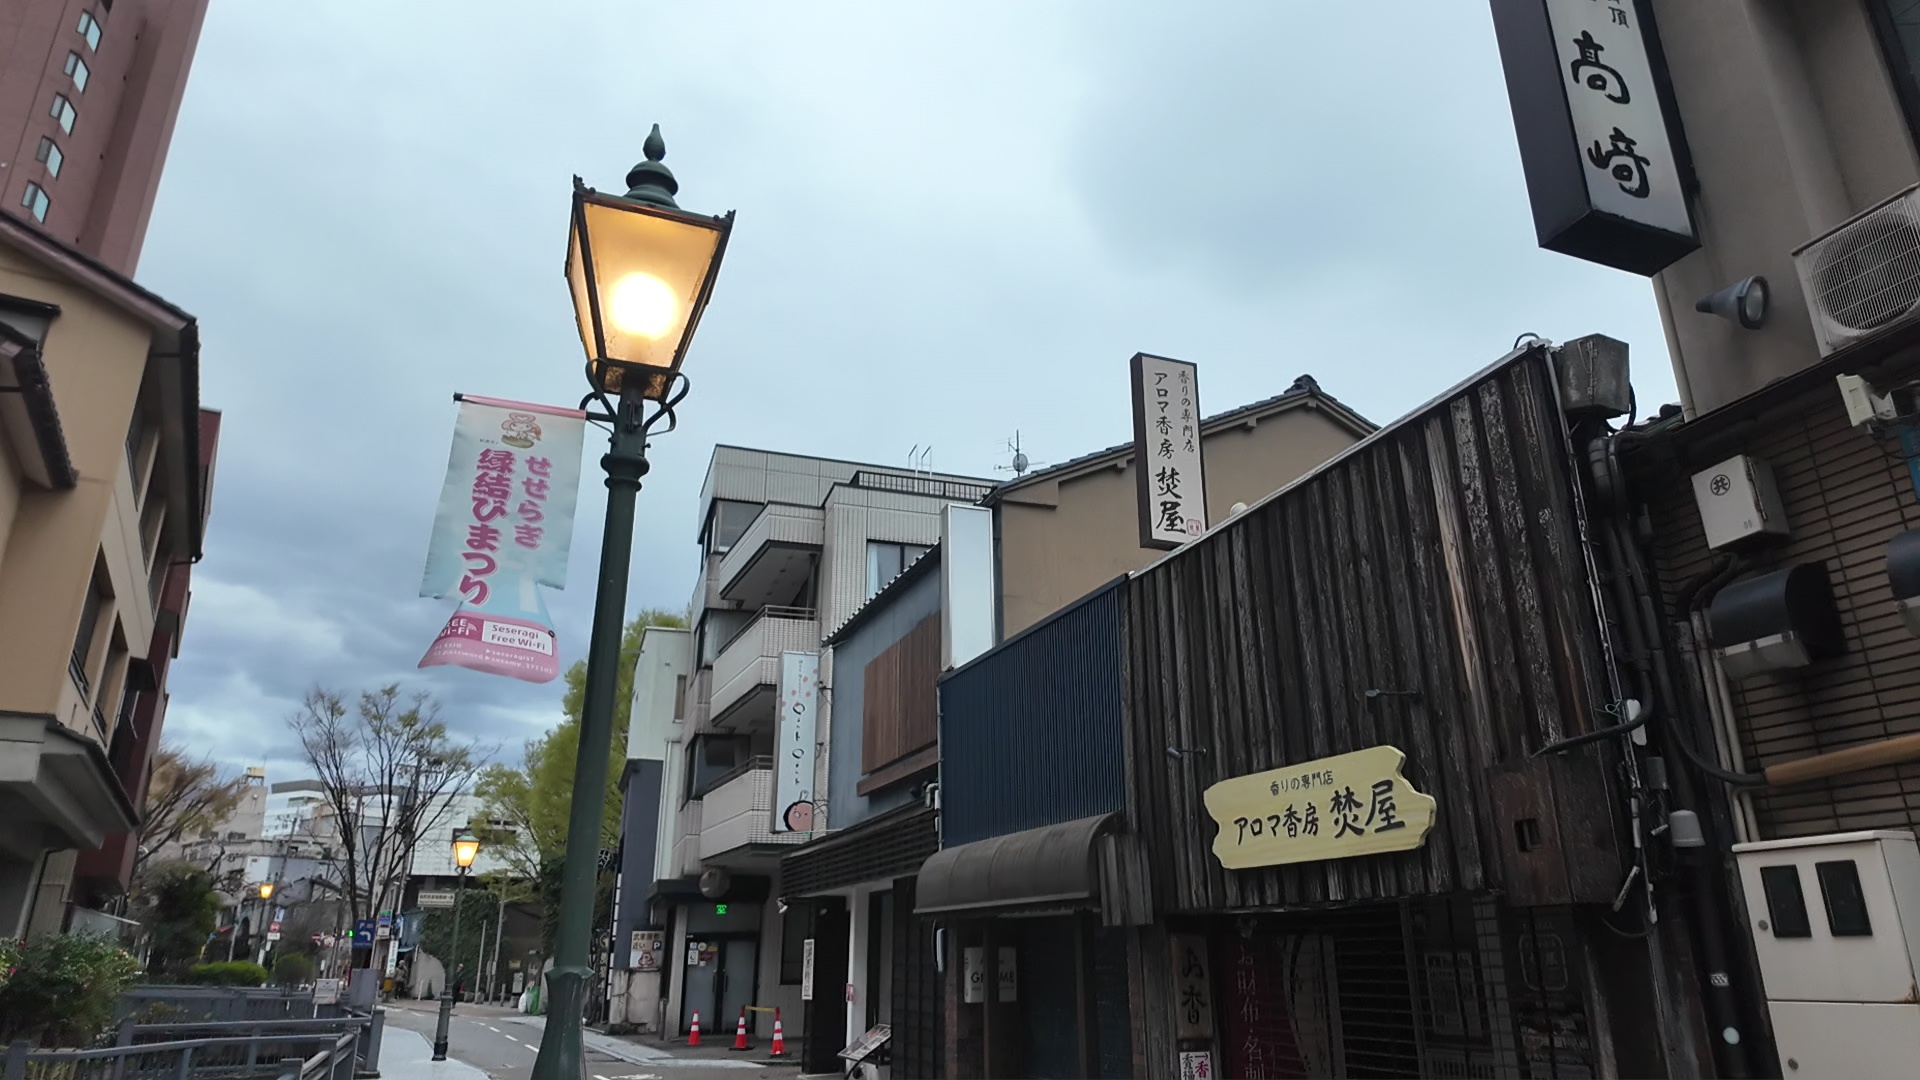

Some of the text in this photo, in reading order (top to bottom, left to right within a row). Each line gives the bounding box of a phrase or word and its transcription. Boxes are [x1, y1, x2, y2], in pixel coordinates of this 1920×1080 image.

[1178, 370, 1195, 454] 香りの専門店
[1154, 371, 1187, 535] アロマ香房 焚屋
[458, 447, 517, 607] 縁結びまつり
[514, 455, 552, 549] せせらぎ
[491, 634, 546, 651] Free Wi-Fi
[492, 624, 539, 640] Seseragi
[1233, 779, 1406, 845] アロマ香房 焚屋
[1270, 769, 1334, 796] 香りの専門店
[653, 941, 661, 950] P
